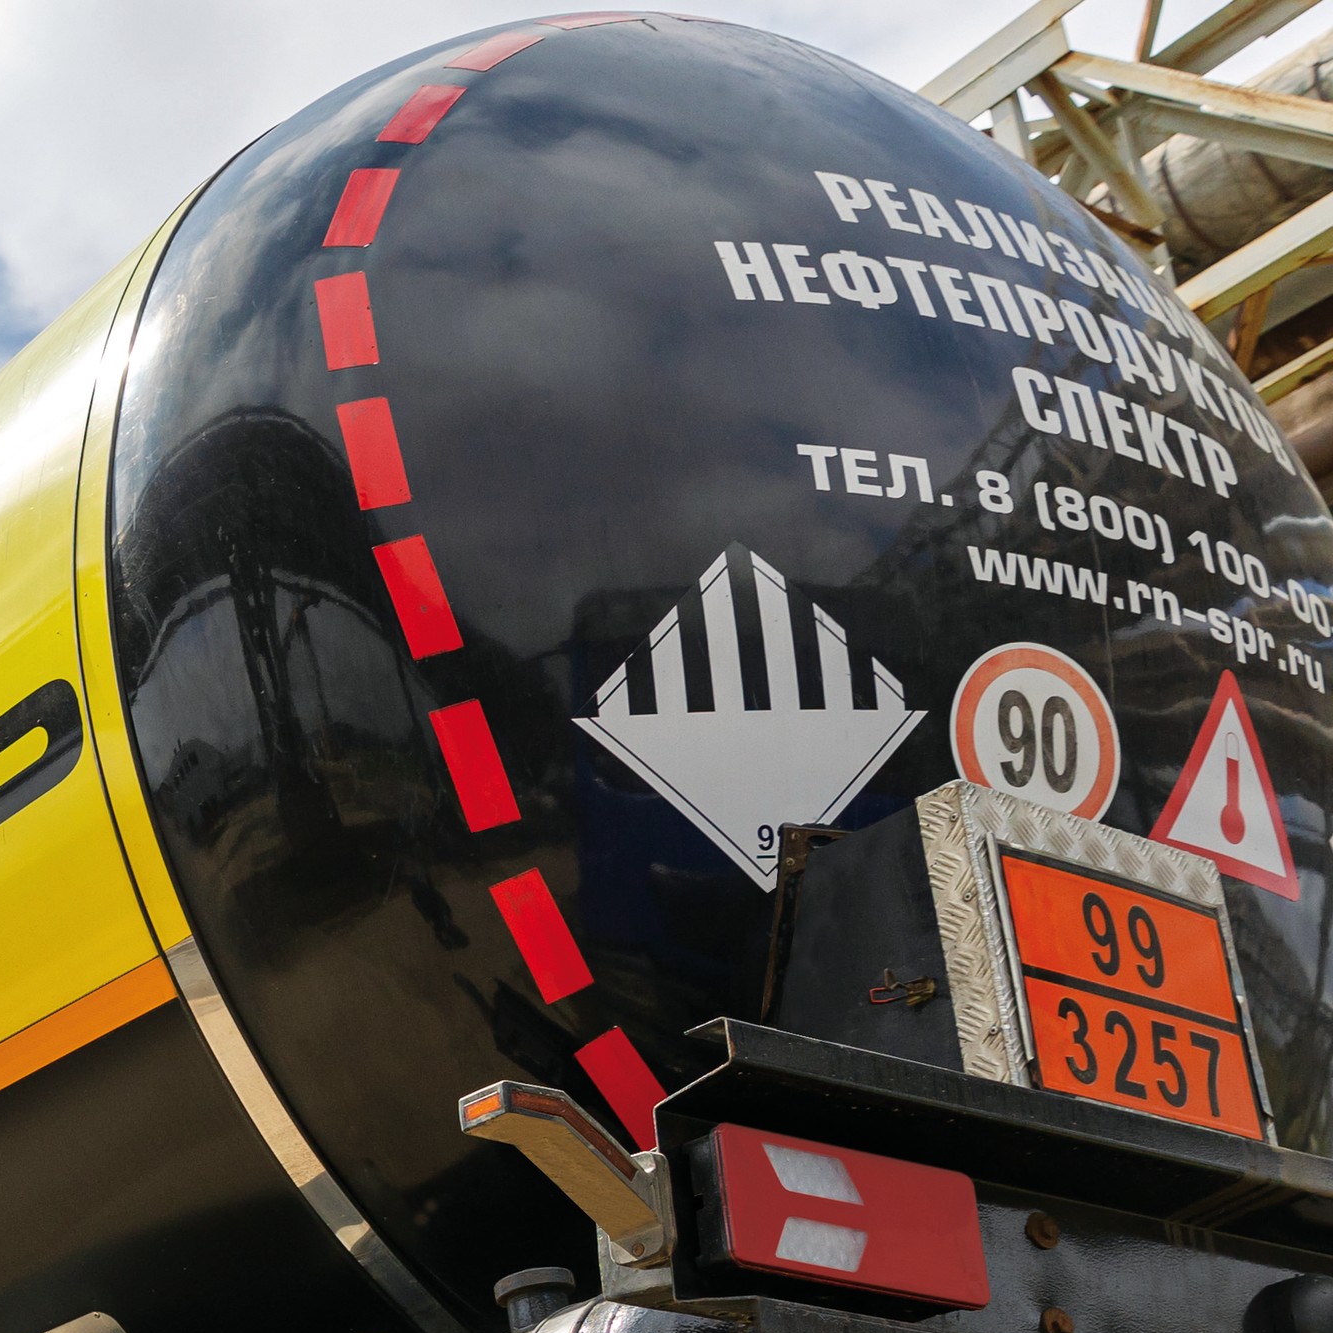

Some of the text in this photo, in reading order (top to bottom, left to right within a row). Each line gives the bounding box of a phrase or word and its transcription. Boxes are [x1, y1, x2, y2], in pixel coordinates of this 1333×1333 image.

[714, 242, 1297, 477] НЕФТЕПРОДУКТОВ
[1012, 366, 1238, 499] СПЕКТР
[796, 444, 1333, 638] ТЕЛ. 8 (800) 100-00
[967, 546, 1325, 694] www.rn-spr.ru
[997, 689, 1076, 794] 90
[757, 824, 775, 851] 9
[1082, 892, 1166, 988] 99
[1057, 998, 1222, 1118] 3257
